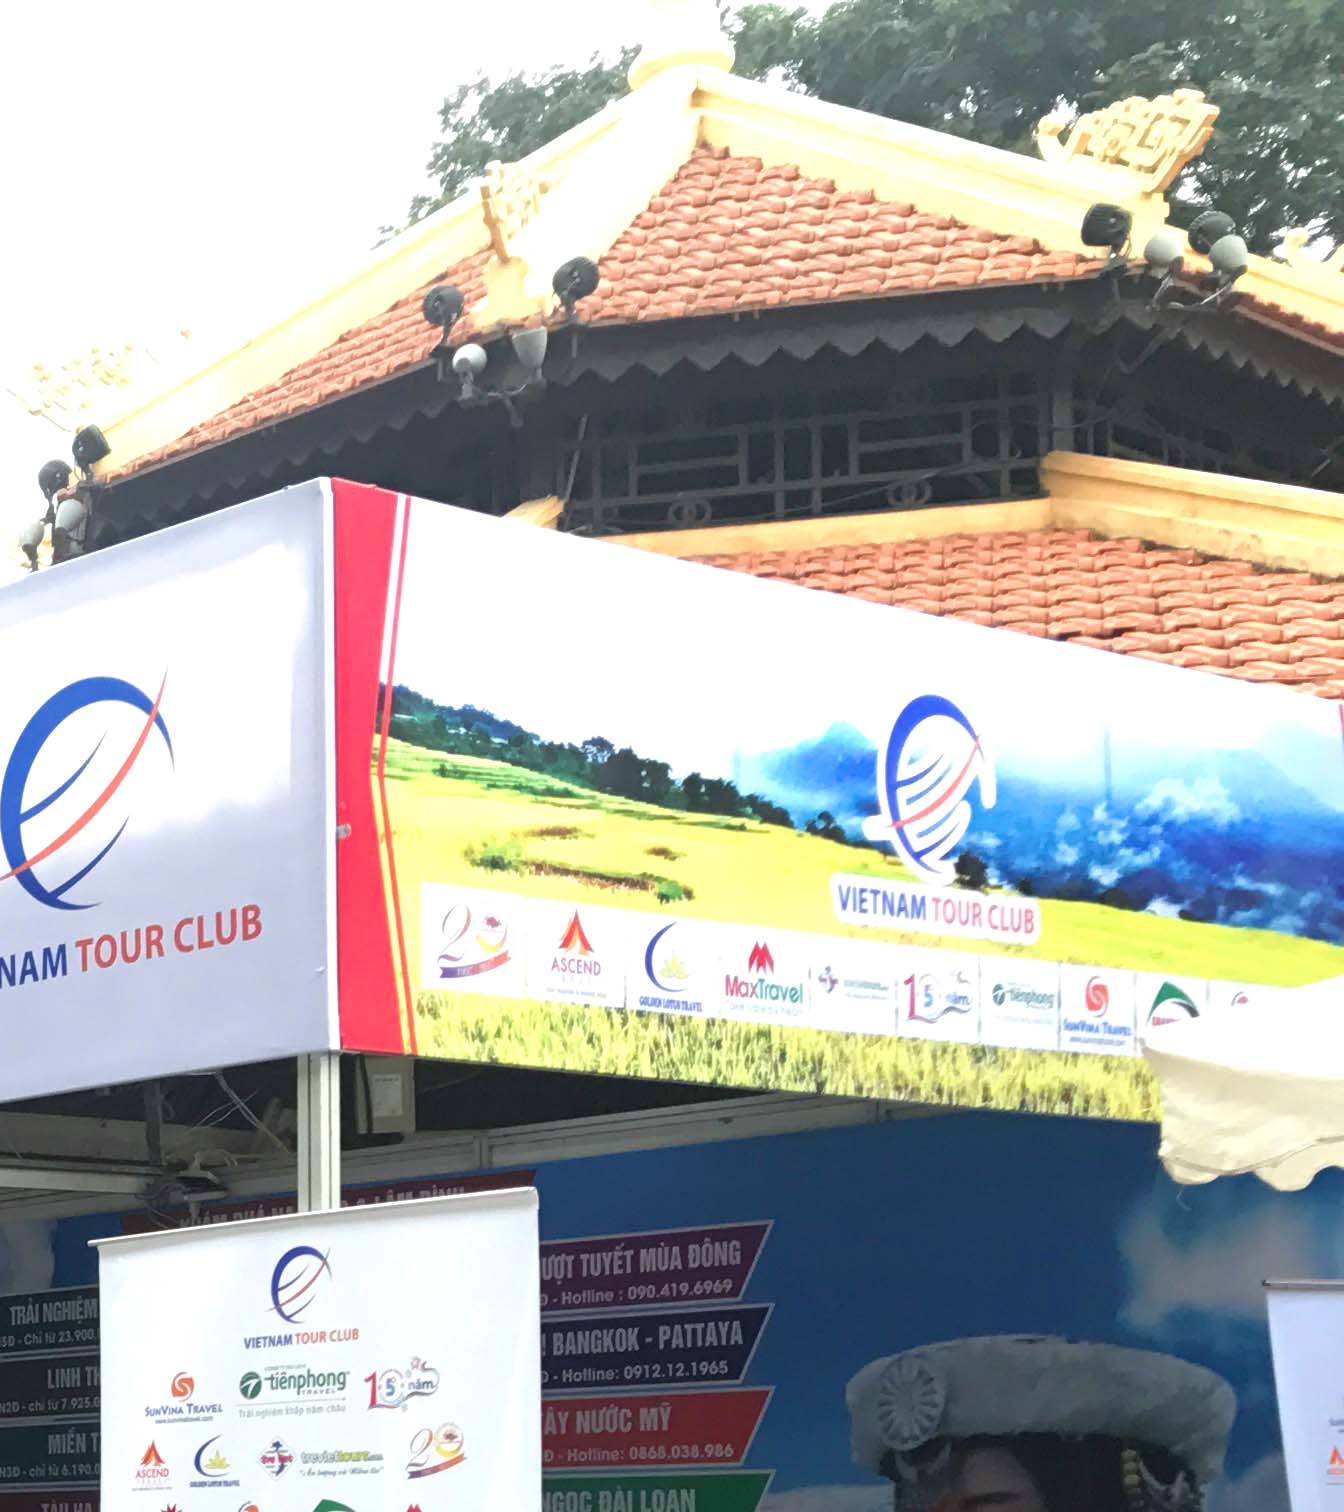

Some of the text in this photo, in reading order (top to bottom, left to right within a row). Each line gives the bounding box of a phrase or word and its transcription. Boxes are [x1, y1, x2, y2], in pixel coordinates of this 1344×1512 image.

[838, 883, 1035, 934] VIETNAM TOUR CLUB
[75, 923, 167, 974] TOUR
[173, 903, 264, 955] CLUB
[551, 957, 602, 977] ASCEND
[725, 975, 804, 1004] MaxTravel
[541, 1238, 742, 1286] ƯỢT TUYẾT MÙA ĐÔNG
[627, 1278, 733, 1300] 090.419.6969
[42, 1296, 98, 1325] NGHIỆM
[244, 1328, 359, 1350] VIETNAM TOUR CLUB
[553, 1320, 743, 1357] BANGKOK PATTAYA
[47, 1367, 81, 1389] LINH
[562, 1360, 728, 1383] Hotline: 0912.12.1965
[541, 1402, 672, 1436] ÂY NƯỚC MỸ
[567, 1444, 734, 1462] Hotline: 0868.038.986
[135, 1468, 169, 1479] ASCEND
